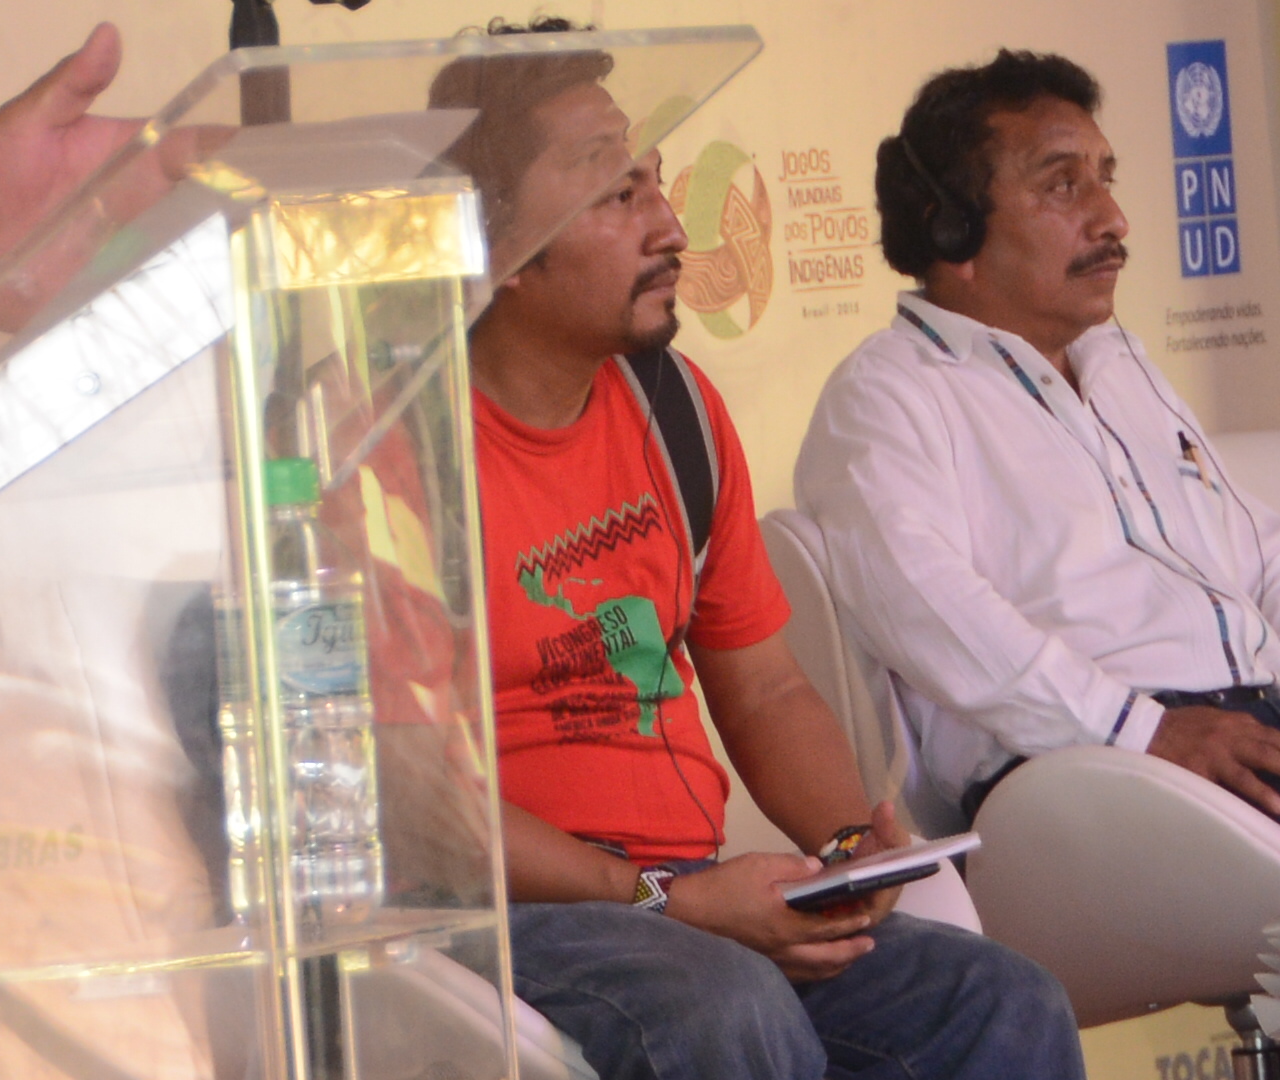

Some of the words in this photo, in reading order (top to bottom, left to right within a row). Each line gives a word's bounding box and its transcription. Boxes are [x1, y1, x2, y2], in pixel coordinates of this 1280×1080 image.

[778, 148, 831, 183] JOGOS
[787, 185, 842, 209] MUNDIAIS
[804, 213, 869, 244] POVOS
